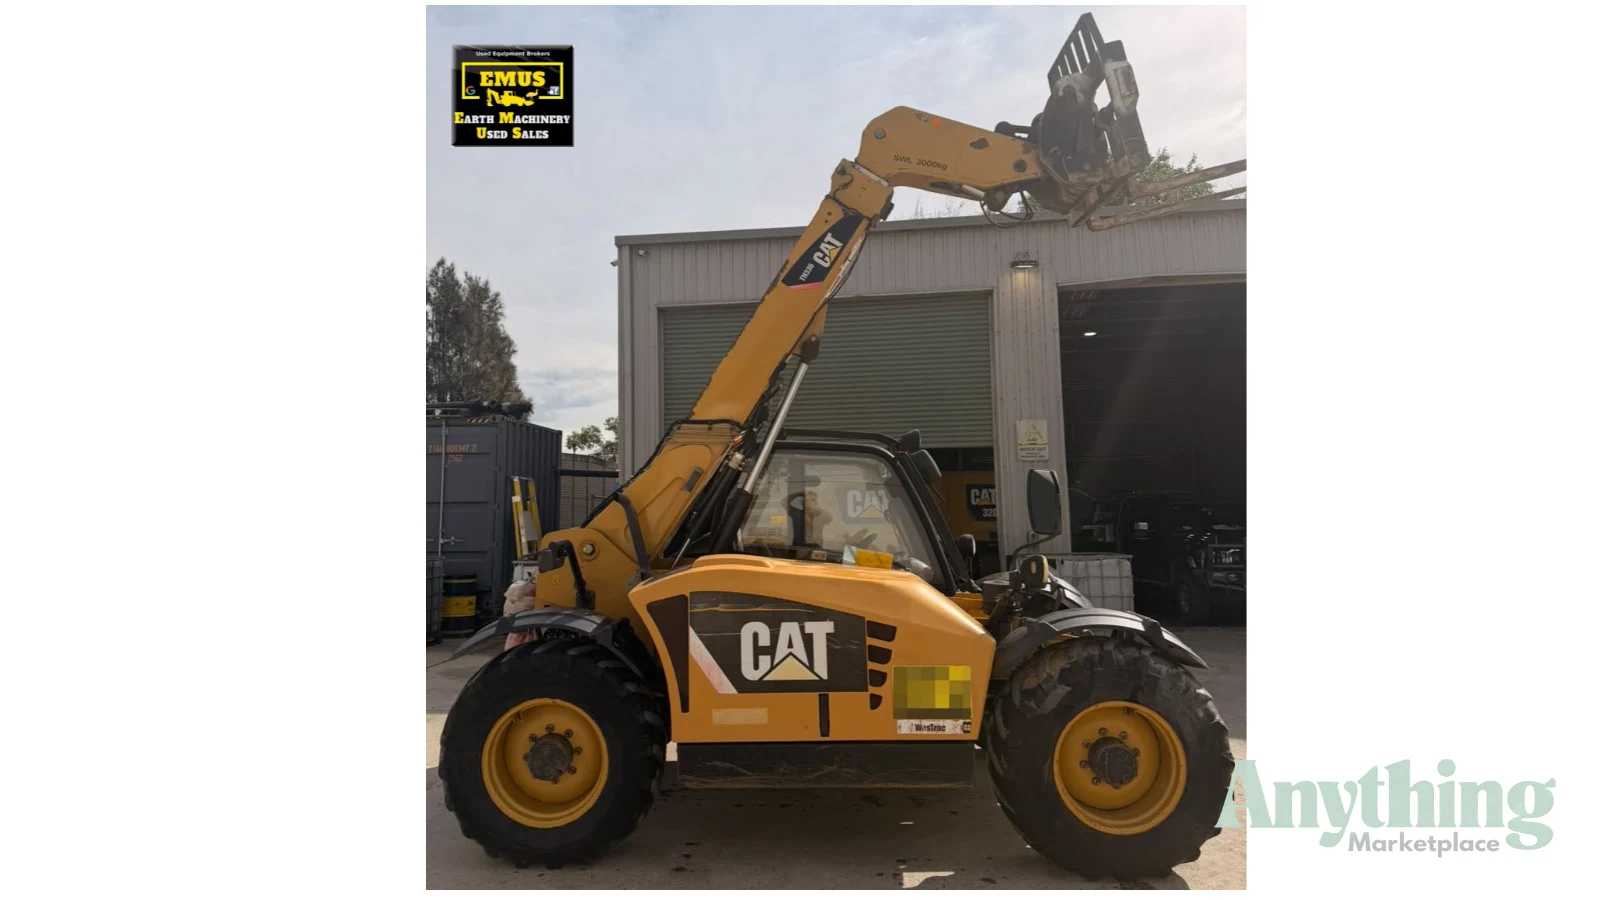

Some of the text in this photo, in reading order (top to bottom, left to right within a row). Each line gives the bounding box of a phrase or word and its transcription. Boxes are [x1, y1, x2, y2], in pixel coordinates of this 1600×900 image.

[893, 154, 948, 171] SWL 3000kg
[813, 232, 843, 268] CAT
[799, 262, 815, 281] TH336
[740, 621, 835, 681] CAT
